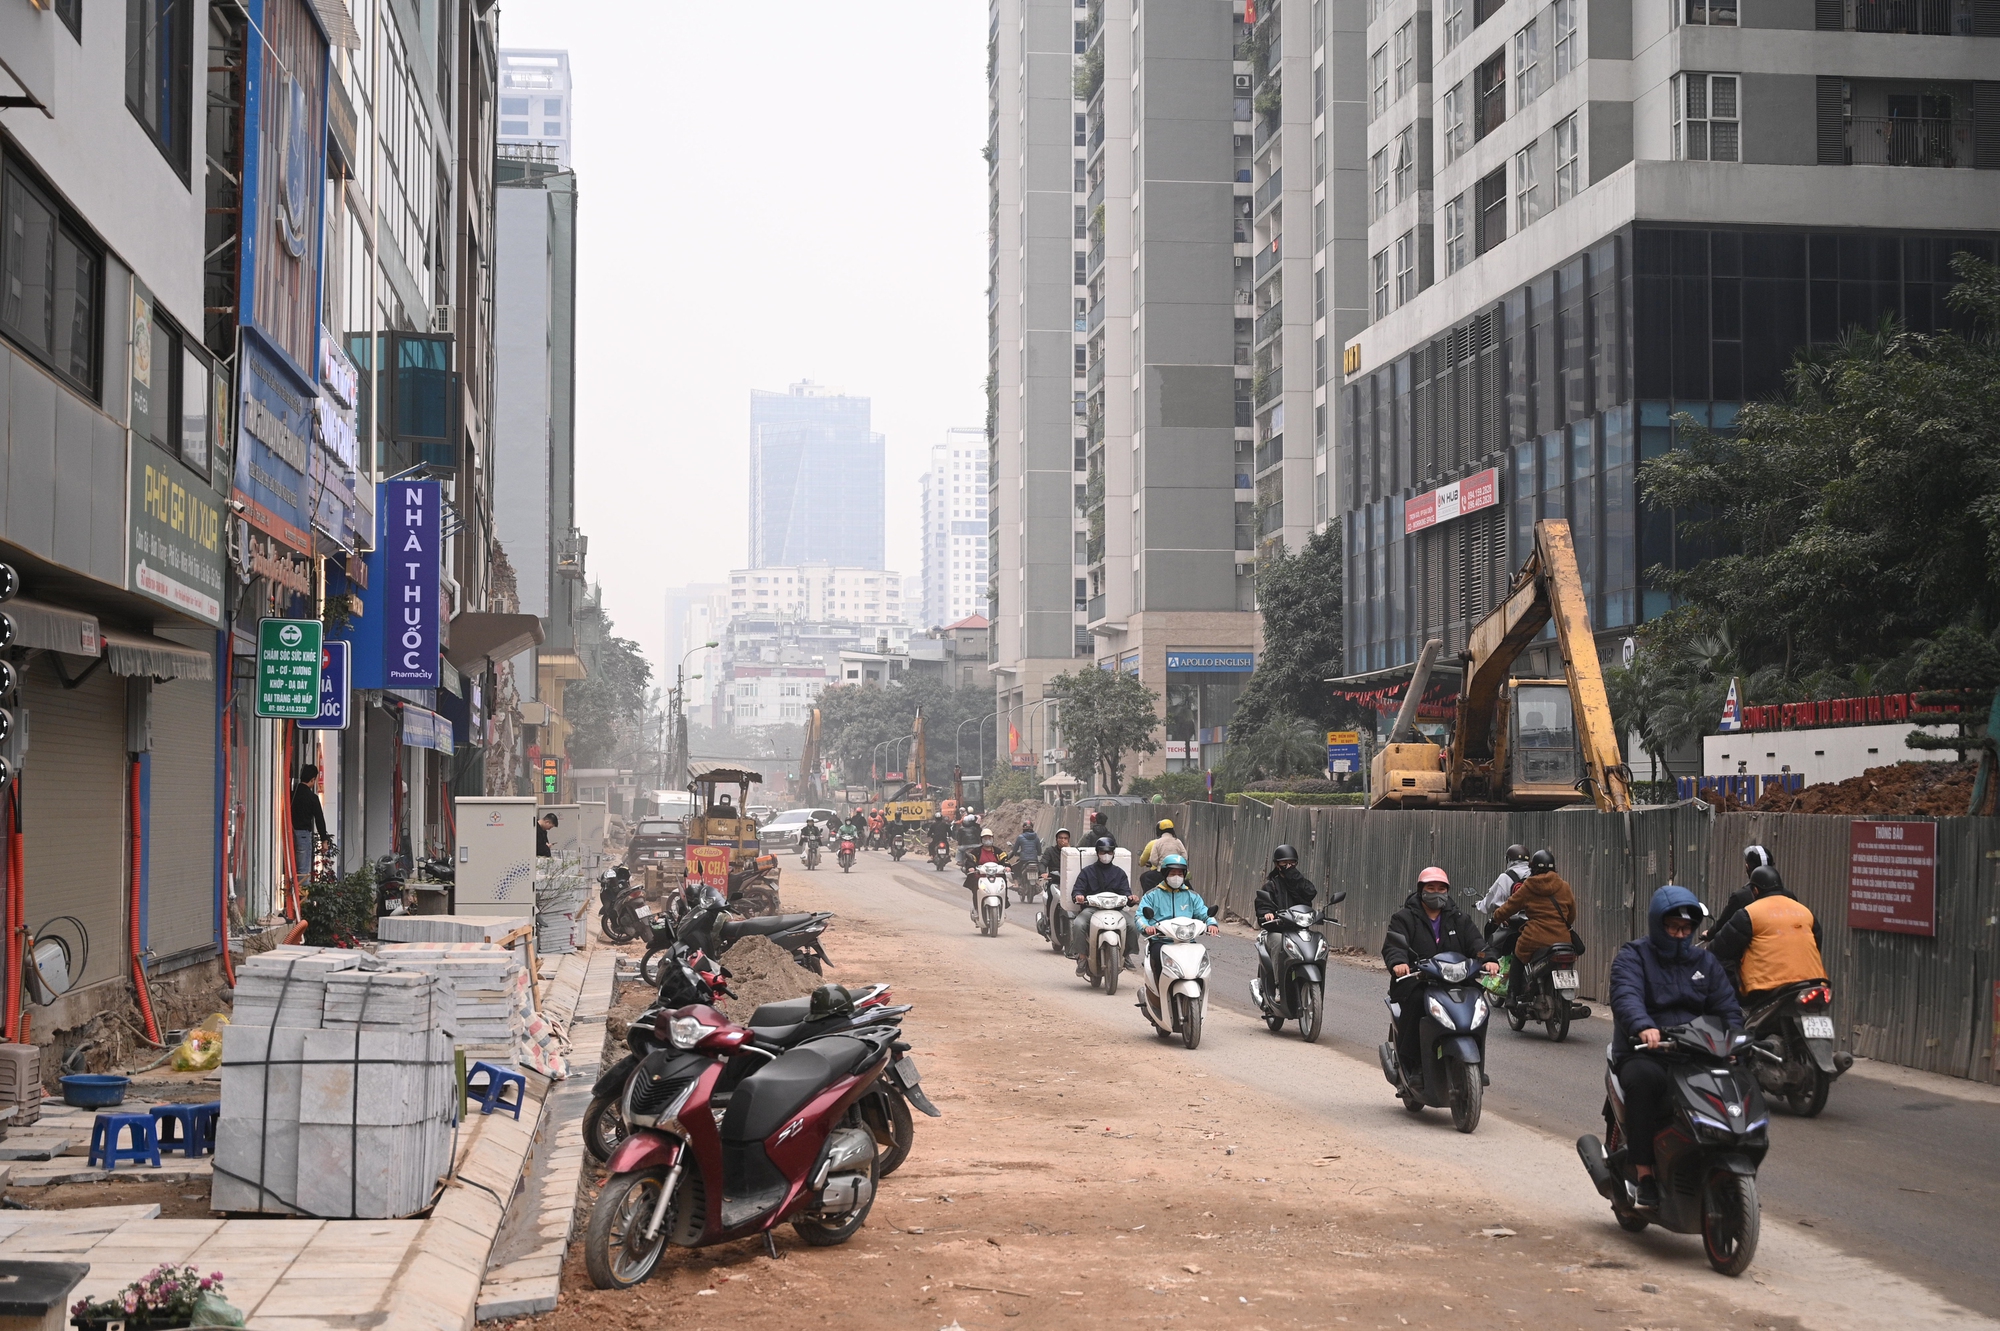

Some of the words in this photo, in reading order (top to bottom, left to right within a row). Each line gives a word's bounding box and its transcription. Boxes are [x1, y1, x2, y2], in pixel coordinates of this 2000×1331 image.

[144, 464, 168, 523] PHỞ
[170, 478, 185, 534] GÀ
[188, 493, 198, 549] VỊ
[404, 488, 422, 552] NHÀ
[402, 562, 422, 670] THUỐC
[263, 648, 279, 661] CHĂM
[279, 648, 291, 661] SÓC
[291, 649, 302, 661] SỨC
[1181, 658, 1213, 667] APOLLO
[1214, 658, 1251, 667] ENGLISH
[266, 665, 275, 674] DA
[279, 665, 288, 675] CƠ
[390, 669, 433, 680] Pharmacity
[288, 680, 296, 691] DẠ
[1742, 701, 1767, 730] CÔNG
[1875, 824, 1892, 839] THÔNG
[1892, 824, 1904, 840] BÁO
[707, 855, 727, 876] CHẢ
[712, 876, 725, 885] BÒ
